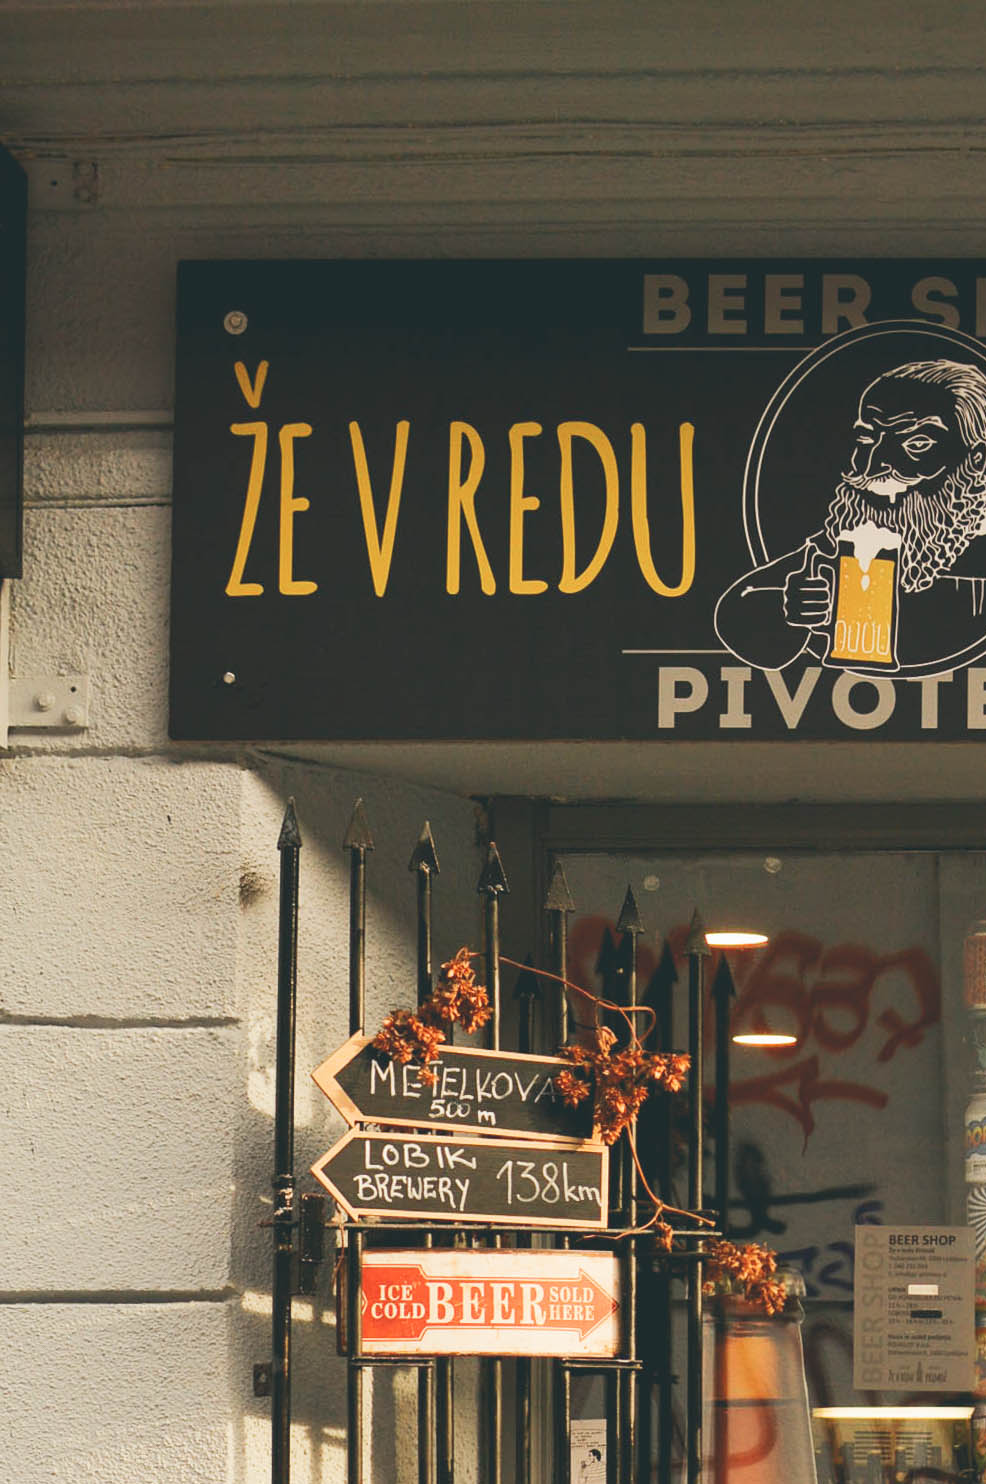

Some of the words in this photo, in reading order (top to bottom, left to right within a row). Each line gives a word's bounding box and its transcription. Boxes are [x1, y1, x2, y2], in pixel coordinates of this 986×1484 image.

[642, 273, 873, 334] BEER
[225, 360, 319, 597] ŽE
[349, 420, 410, 597] V
[447, 420, 697, 597] REDU
[477, 1109, 497, 1126] m
[364, 1140, 477, 1171] LOBIK
[353, 1173, 471, 1212] BREWERY
[888, 1234, 920, 1247] BEER
[921, 1234, 957, 1247] SHOP
[379, 1284, 413, 1301] ICE
[549, 1285, 595, 1304] SOLD
[370, 1302, 426, 1320] COLD
[425, 1281, 547, 1326] BEER
[549, 1304, 595, 1322] HERE
